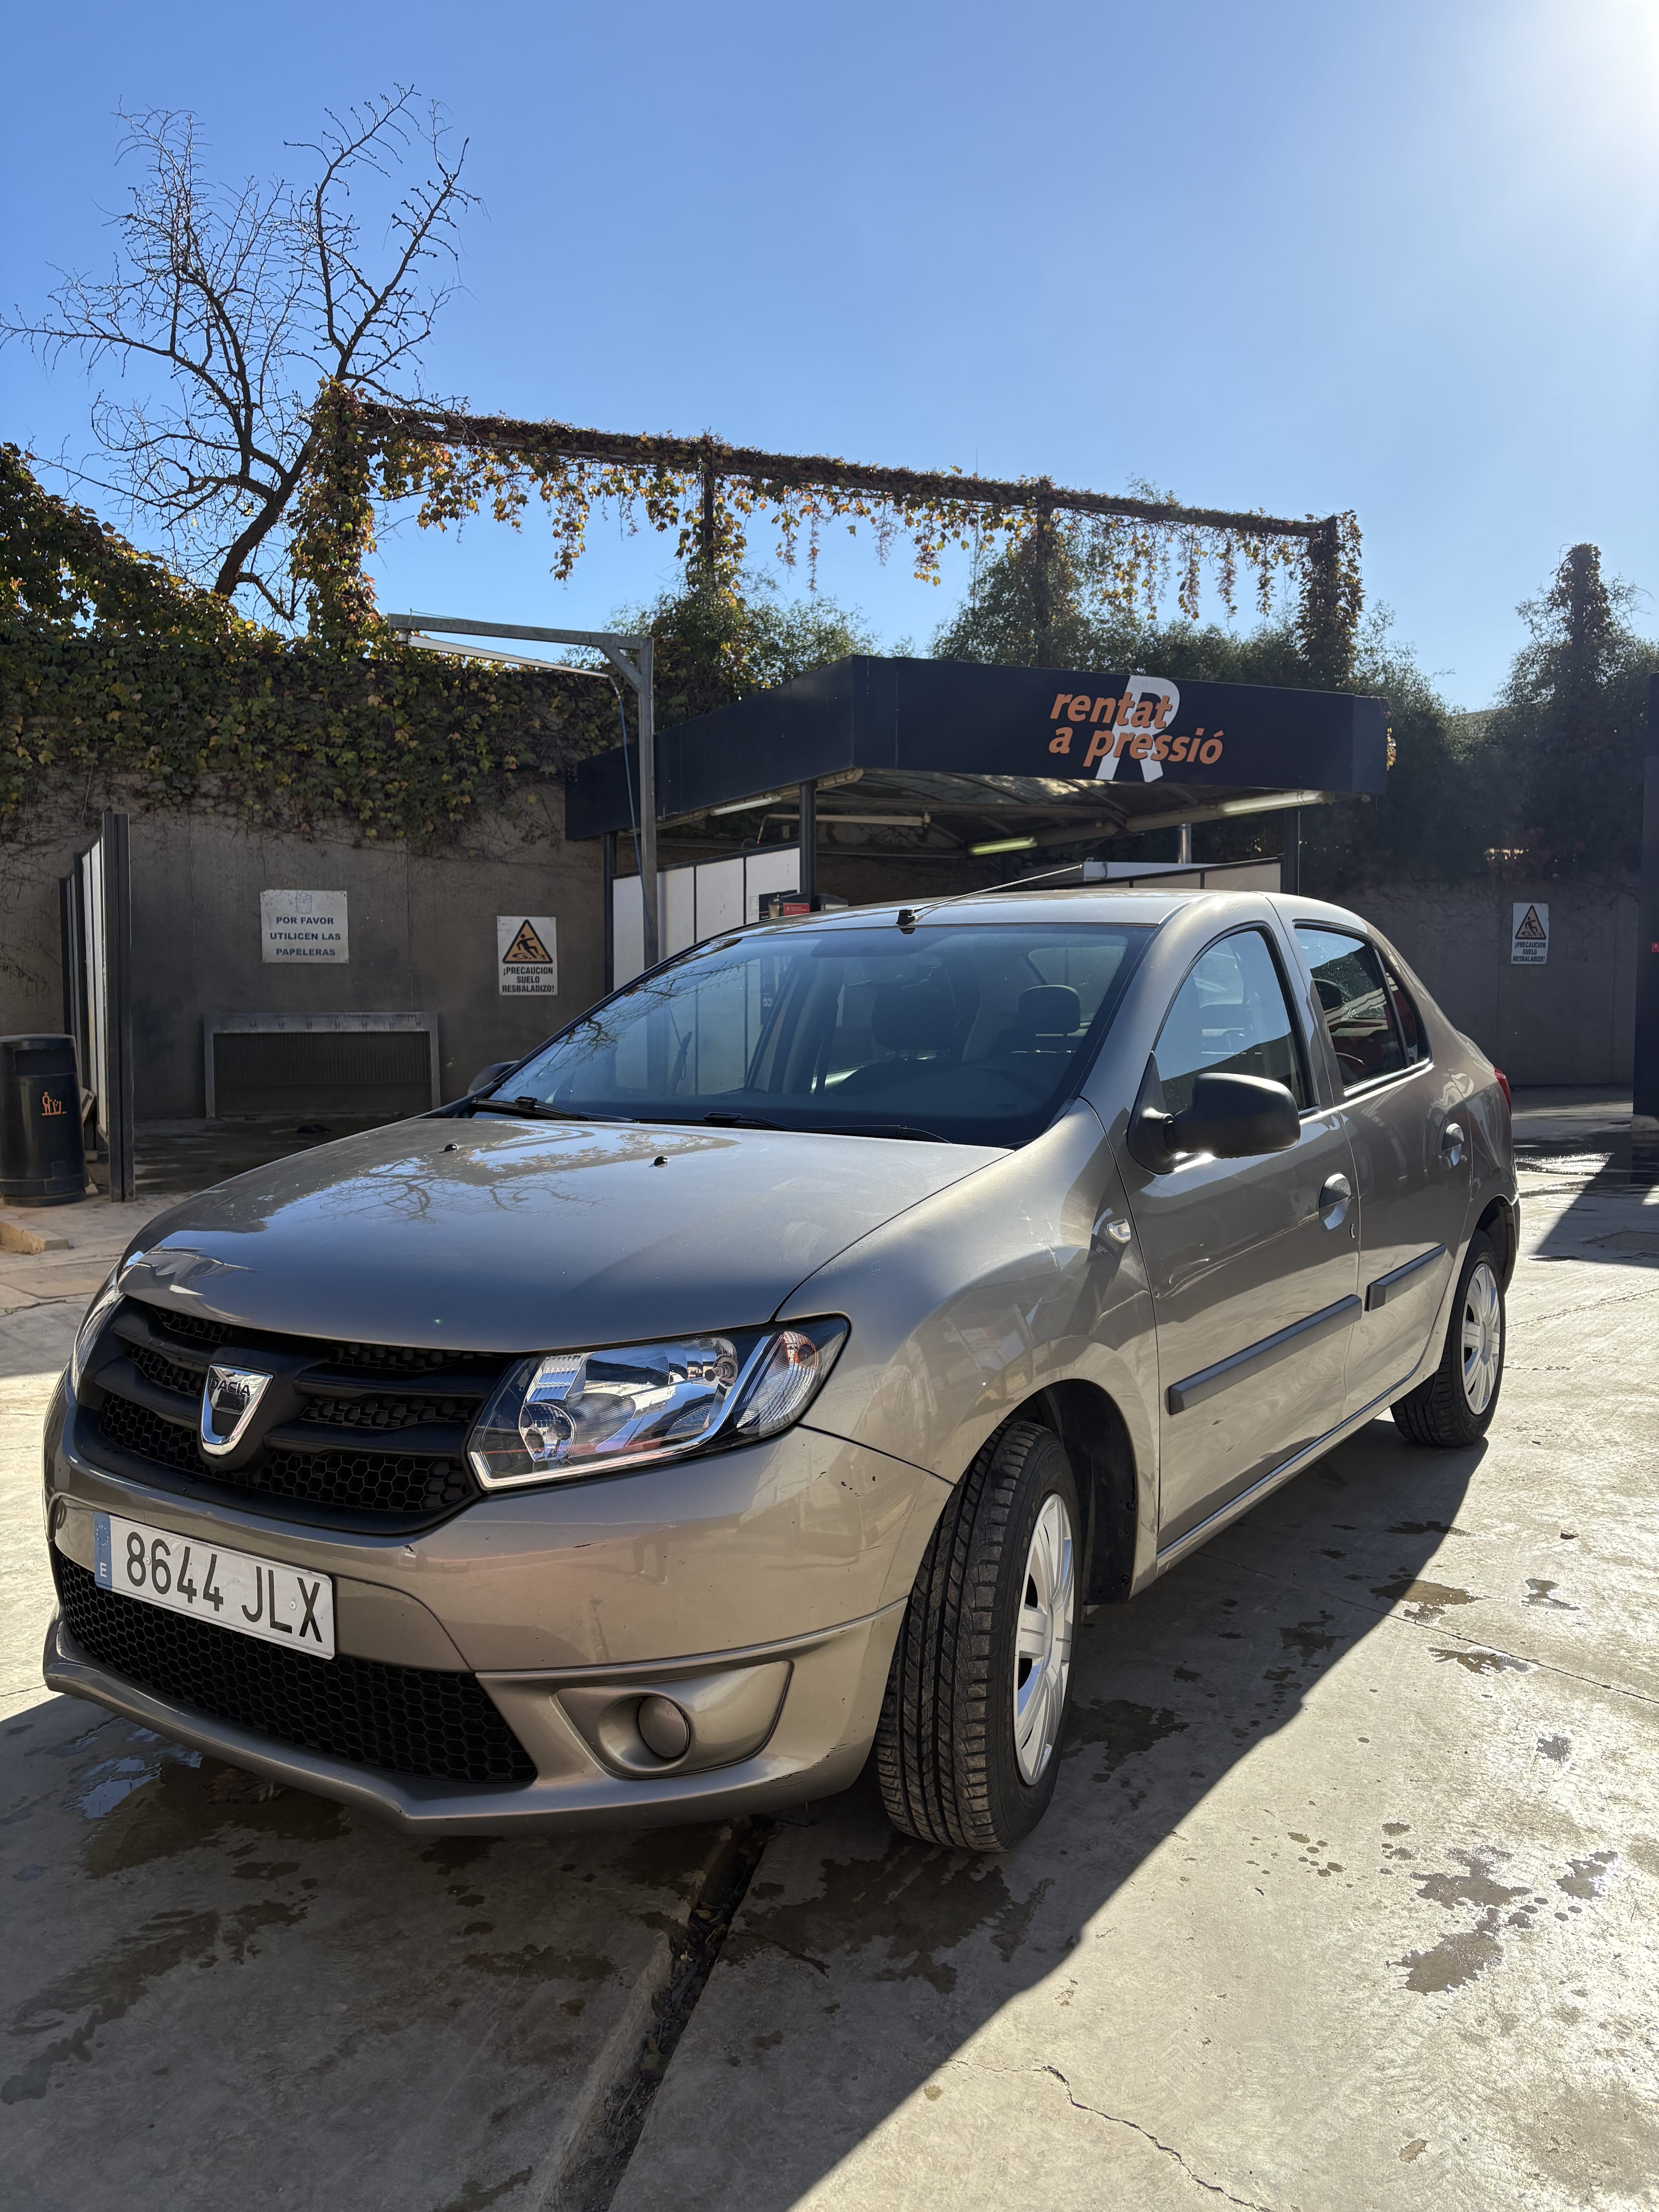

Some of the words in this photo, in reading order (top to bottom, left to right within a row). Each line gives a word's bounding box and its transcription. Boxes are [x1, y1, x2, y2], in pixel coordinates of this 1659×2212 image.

[1050, 692, 1172, 728] rentat
[1048, 726, 1073, 754] a
[1083, 728, 1224, 767] pressió
[503, 967, 553, 975] ¡PRECAUCION
[209, 1378, 251, 1397] DACIA
[99, 1561, 107, 1578] E
[127, 1532, 223, 1612] 8644
[241, 1566, 323, 1643] JLX
